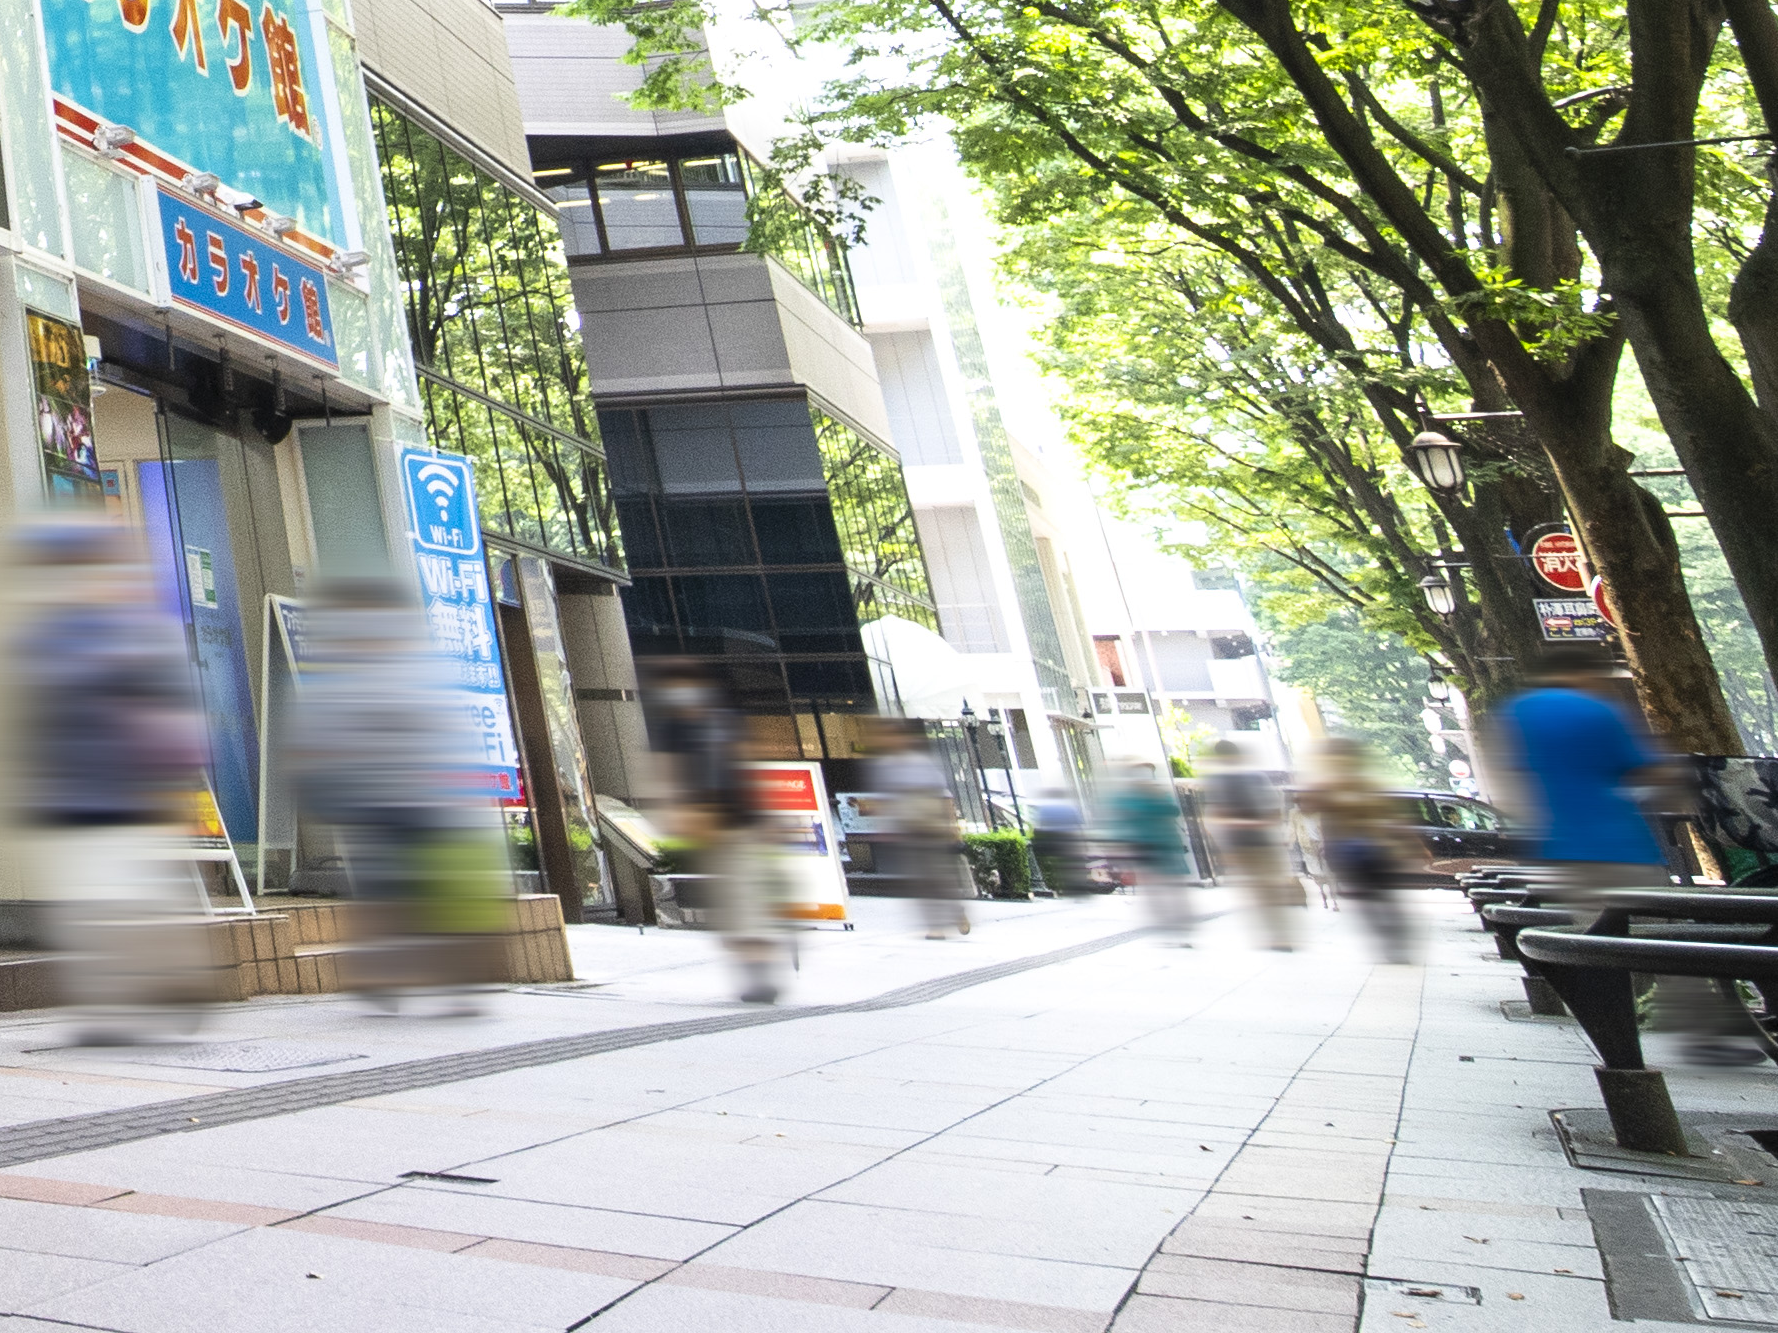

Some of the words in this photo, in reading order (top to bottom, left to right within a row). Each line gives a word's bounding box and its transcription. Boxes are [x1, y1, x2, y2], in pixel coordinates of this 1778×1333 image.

[174, 216, 326, 345] カラオケ館
[429, 524, 464, 548] Wi-Fi
[417, 553, 488, 603] Wi-Fi
[1540, 552, 1582, 573] 消火
[427, 598, 493, 661] 無料
